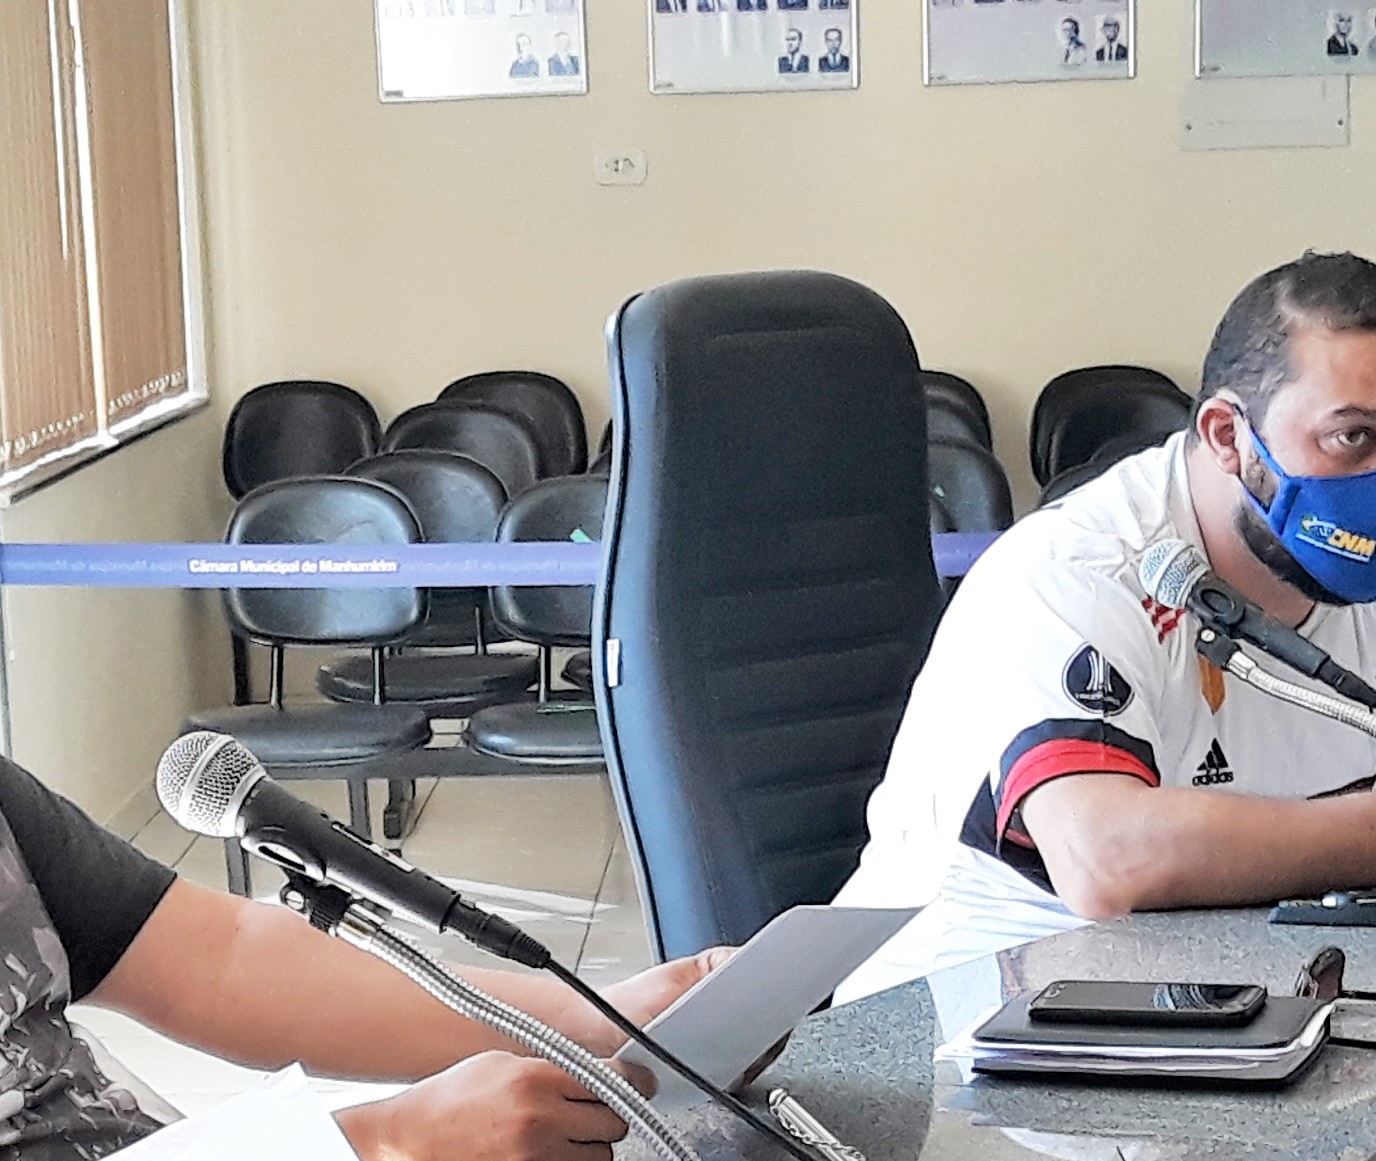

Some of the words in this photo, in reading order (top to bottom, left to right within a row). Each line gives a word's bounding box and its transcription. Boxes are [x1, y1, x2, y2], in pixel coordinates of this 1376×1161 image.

[188, 558, 238, 574] Câmara
[238, 558, 300, 576] Municipal
[301, 560, 317, 574] de
[1191, 768, 1234, 787] adidas
